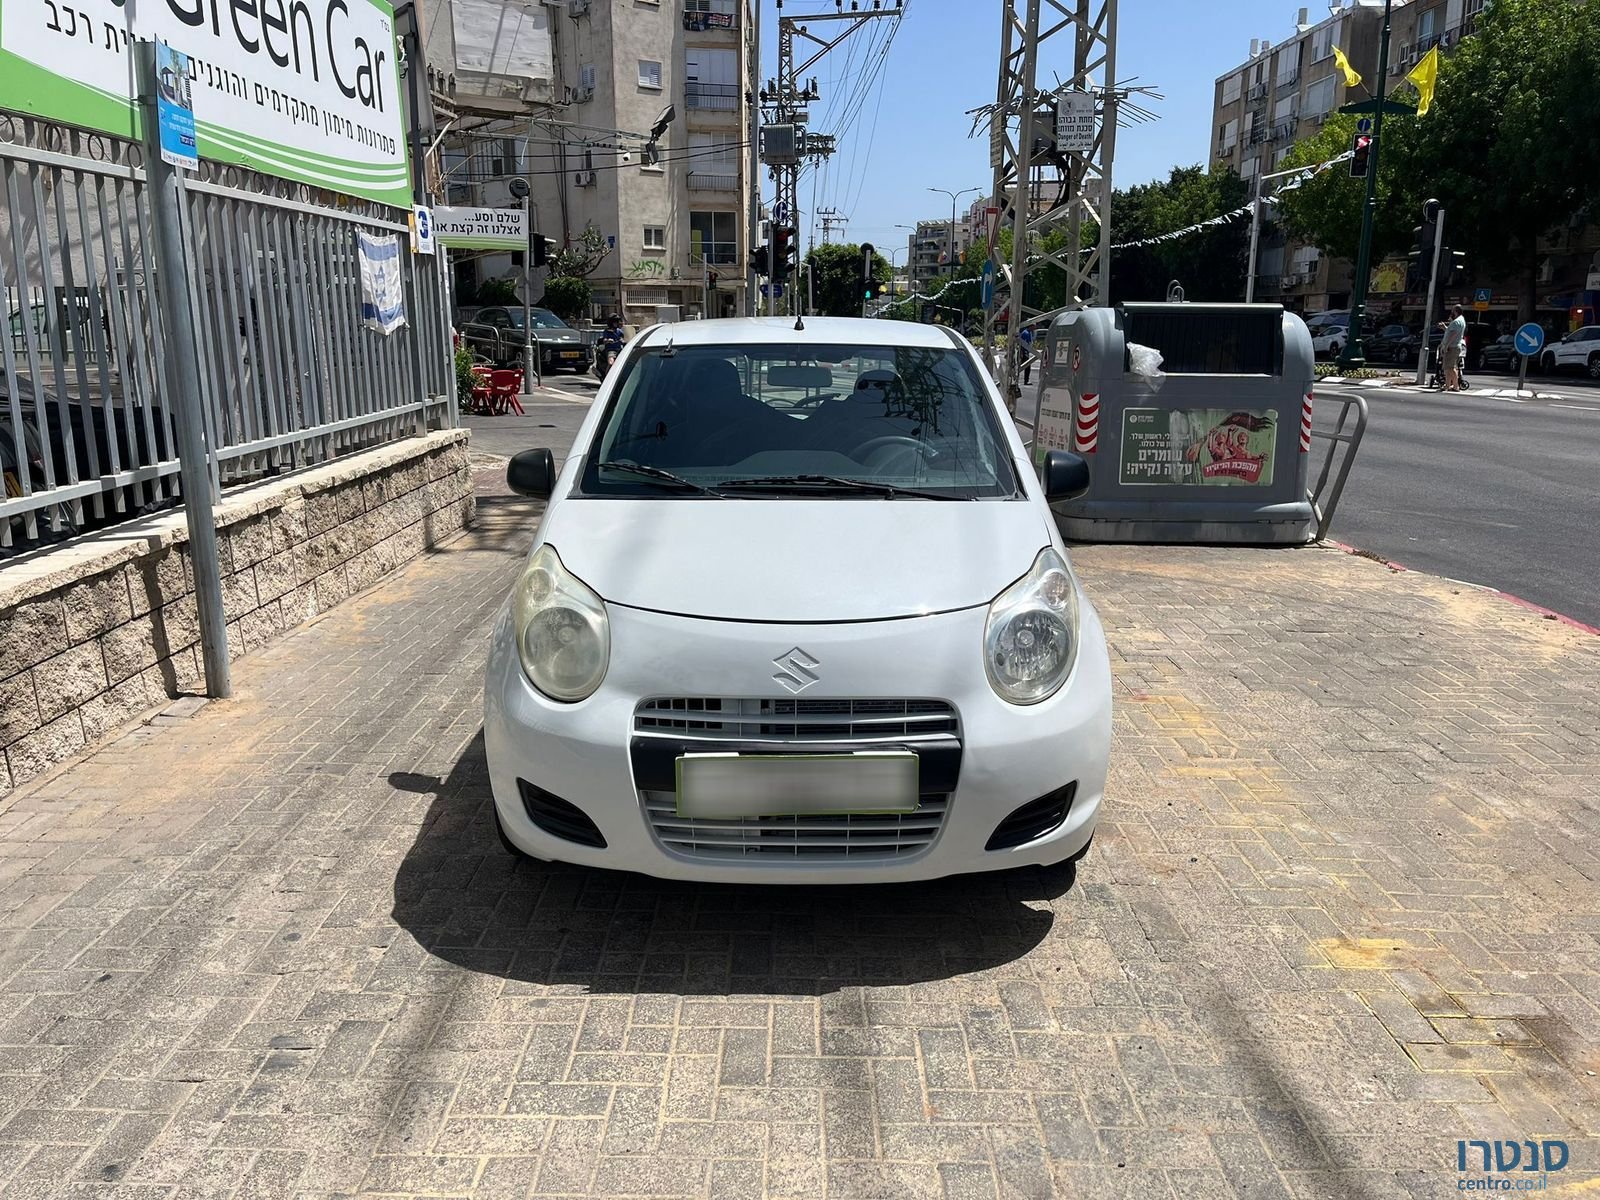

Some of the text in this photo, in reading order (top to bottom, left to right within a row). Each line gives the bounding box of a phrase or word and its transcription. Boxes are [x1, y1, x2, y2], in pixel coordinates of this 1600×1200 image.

[45, 0, 93, 44] רכב
[166, 0, 385, 112] een Car
[186, 55, 248, 100] והוגנים
[255, 83, 319, 127] מתקדמים
[322, 110, 353, 140] מימון
[357, 124, 396, 155] פתרונות
[1058, 133, 1073, 141] Danger
[464, 213, 520, 223] שלם וסע...
[451, 224, 474, 235] קצת
[477, 225, 489, 233] זה
[492, 224, 520, 235] אצלנו
[1138, 449, 1183, 461] שומרים
[1126, 462, 1161, 477] נקייה!
